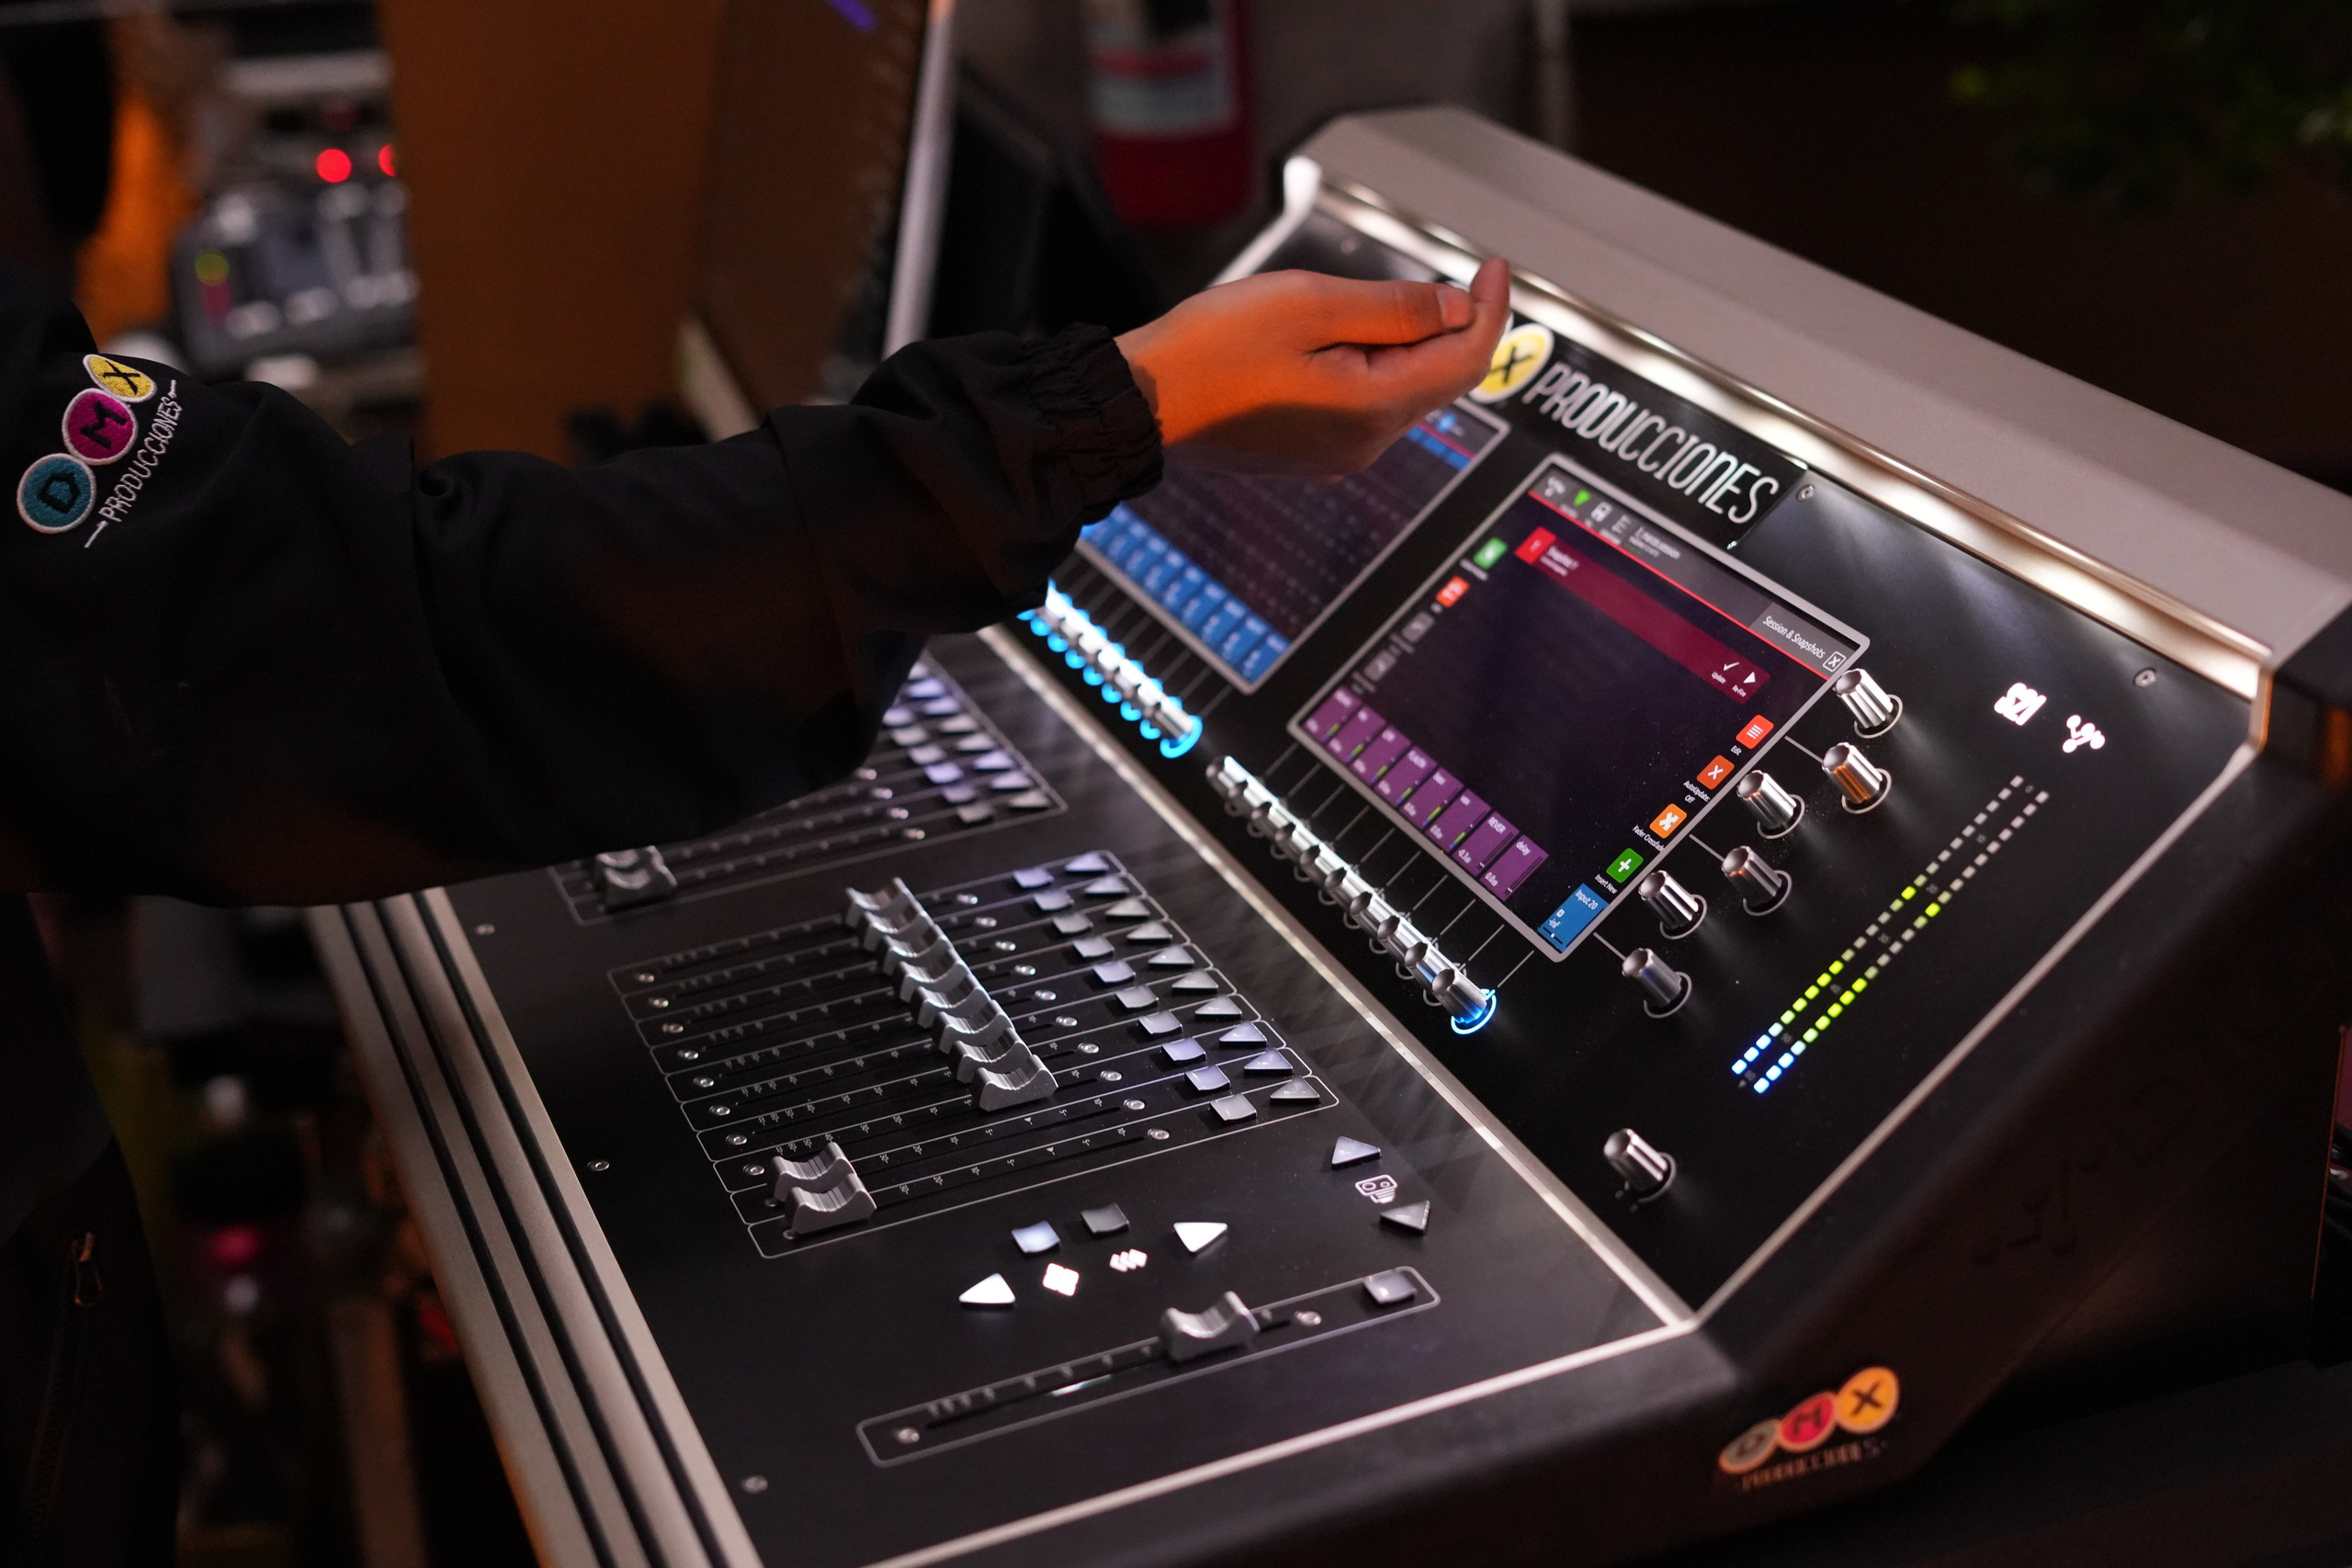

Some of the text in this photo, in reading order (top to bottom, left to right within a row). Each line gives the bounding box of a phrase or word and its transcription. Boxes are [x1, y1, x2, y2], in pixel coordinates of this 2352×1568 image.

[1521, 361, 1781, 525] PRODUCCIONES
[97, 394, 183, 523] PRODUCCIONES
[1762, 615, 1787, 637] Session
[1791, 632, 1826, 660] Snapshots
[1711, 671, 1726, 684] Update
[1730, 745, 1743, 757] Edit
[1684, 795, 1696, 805] Off
[1633, 825, 1646, 840] Fader
[1516, 840, 1531, 856] delay
[1594, 874, 1618, 895] Insert New
[1575, 889, 1599, 910] Input 20
